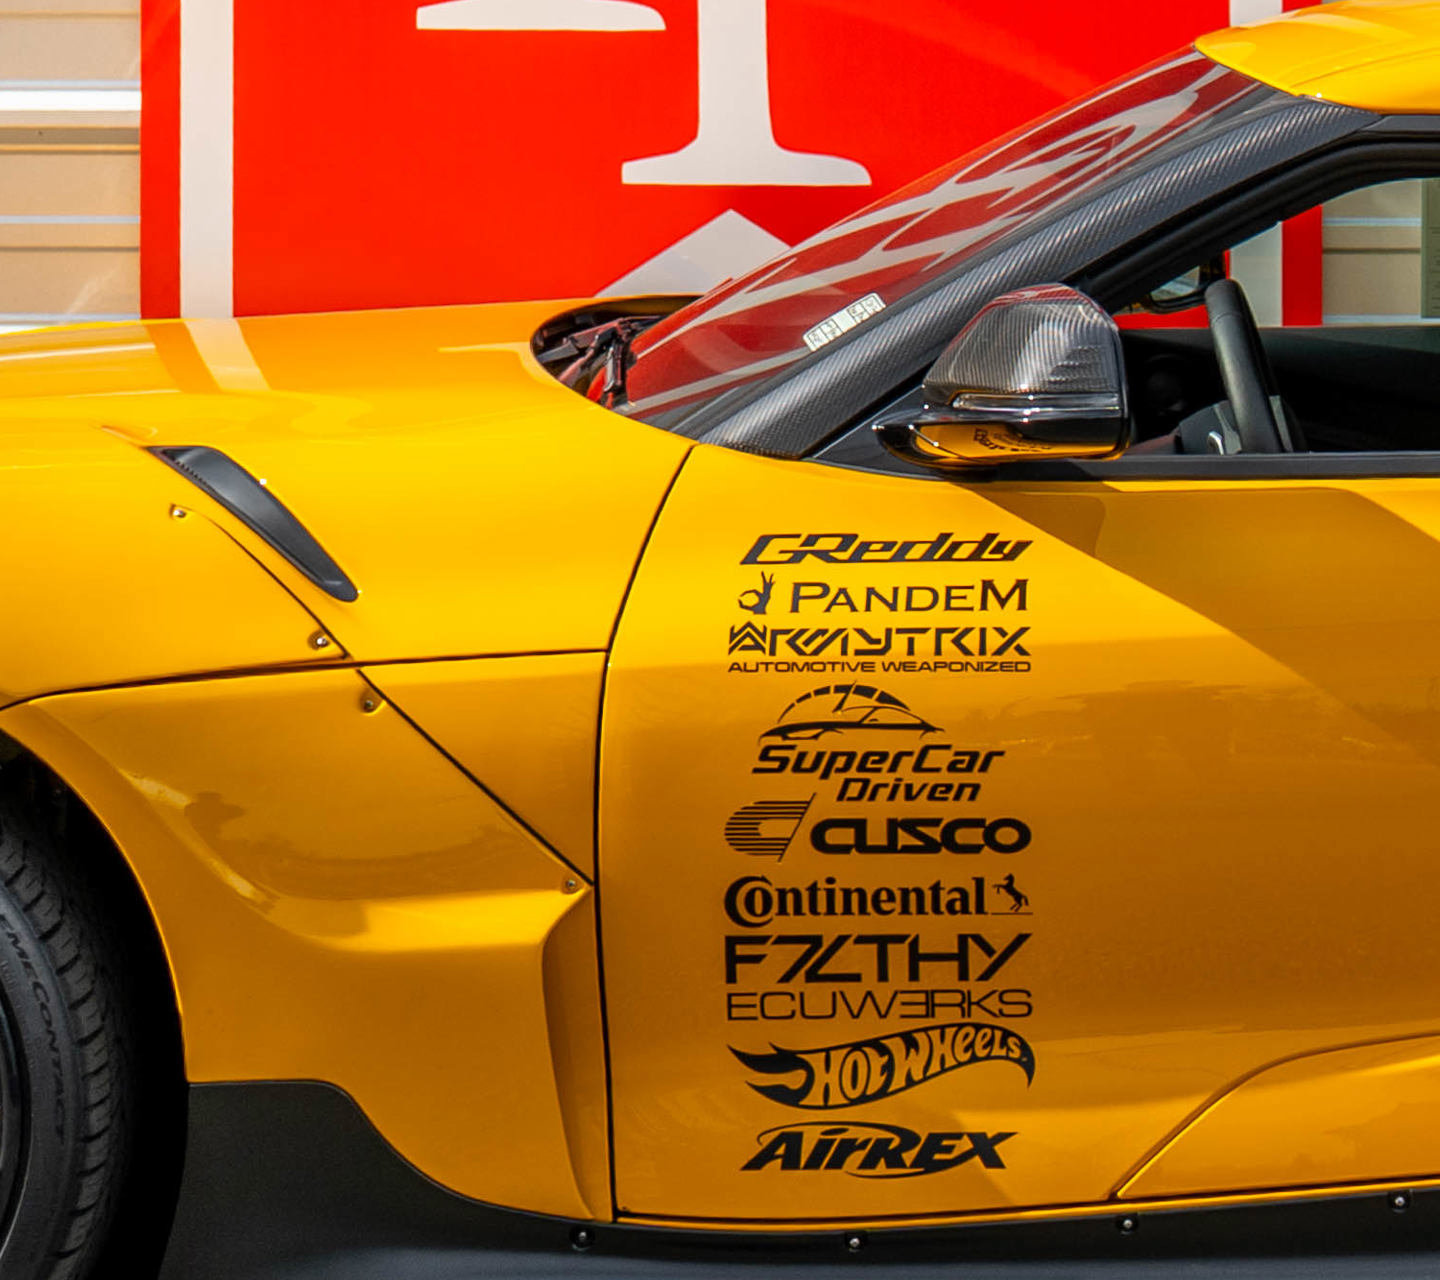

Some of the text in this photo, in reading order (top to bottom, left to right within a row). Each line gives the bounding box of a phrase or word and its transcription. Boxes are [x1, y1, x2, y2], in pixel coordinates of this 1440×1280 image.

[728, 661, 1031, 673] AUTOMOTIVE WEAPONIZED
[752, 744, 1006, 780] SuperCar
[836, 777, 982, 802] Driven
[810, 817, 1032, 855] CUSCO
[724, 875, 989, 928] Continental
